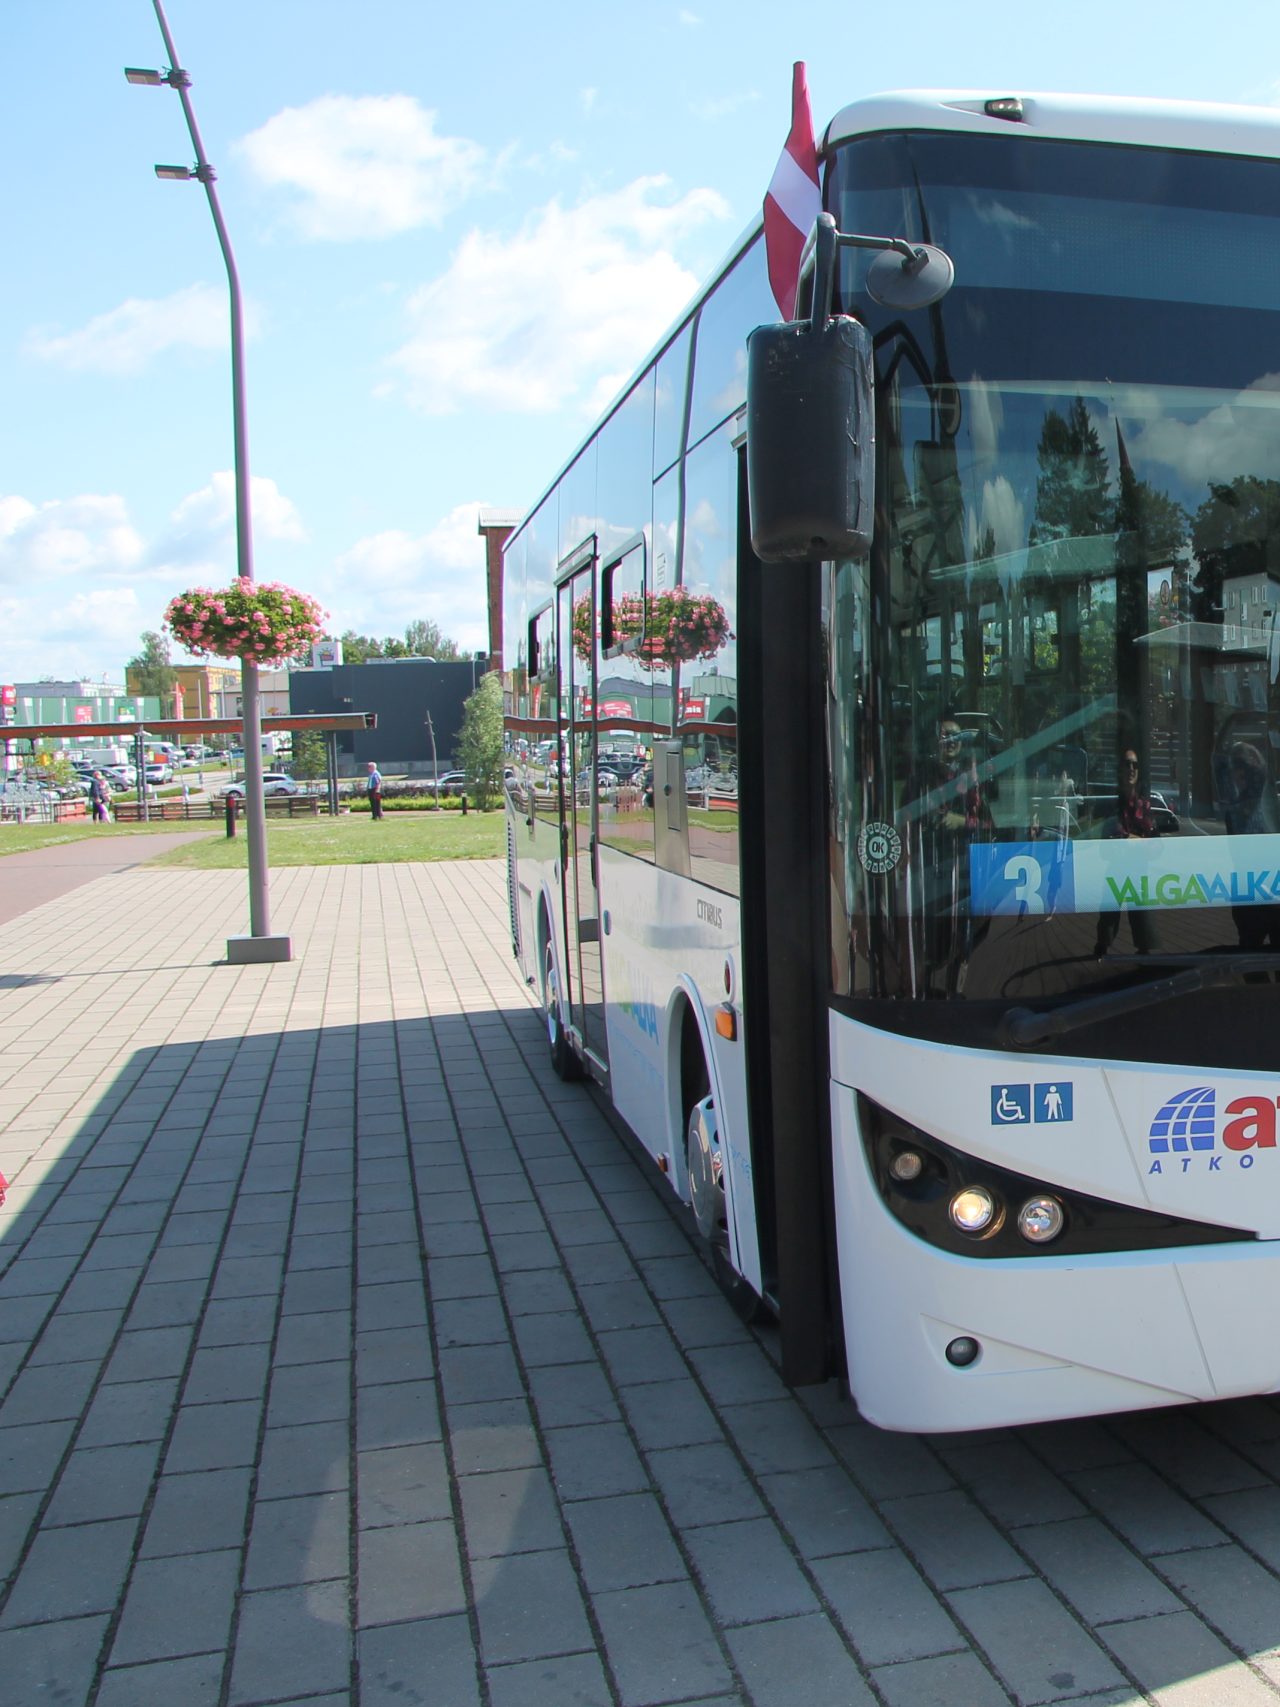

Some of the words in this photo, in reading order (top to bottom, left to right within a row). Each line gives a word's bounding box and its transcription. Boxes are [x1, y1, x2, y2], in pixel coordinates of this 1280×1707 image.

[872, 841, 884, 853] OK
[1004, 855, 1045, 914] 3
[1149, 1154, 1254, 1174] ATKO
